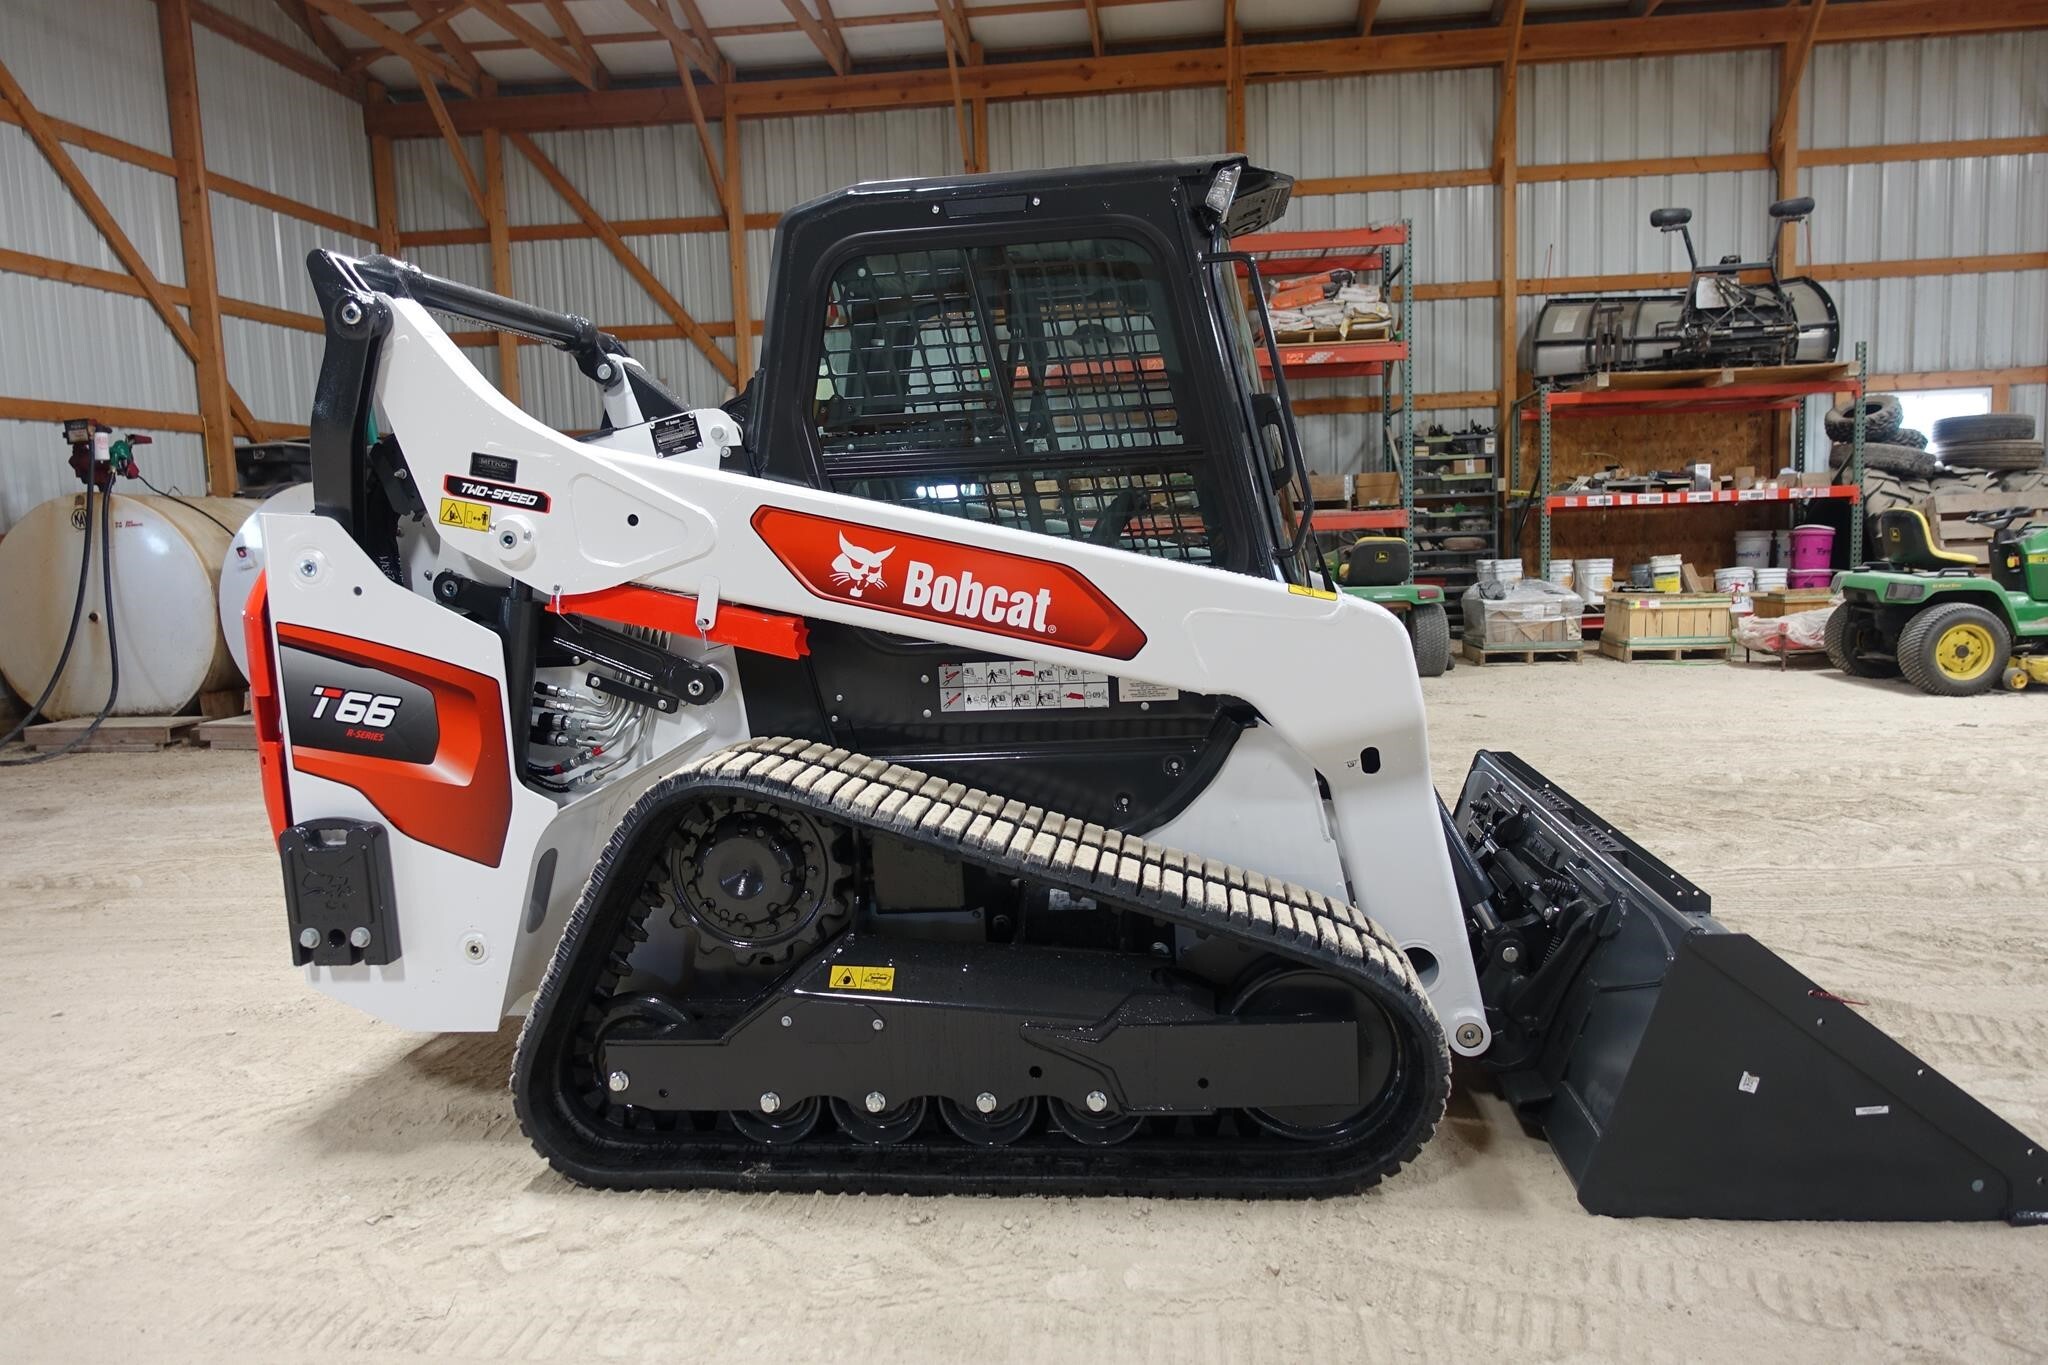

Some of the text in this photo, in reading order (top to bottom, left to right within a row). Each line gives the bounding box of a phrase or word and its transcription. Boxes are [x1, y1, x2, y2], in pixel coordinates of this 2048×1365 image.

[461, 482, 538, 506] TWO-SPEED
[902, 560, 1051, 633] Bobcat
[312, 686, 402, 728] T66
[346, 728, 385, 741] R-SERIES
